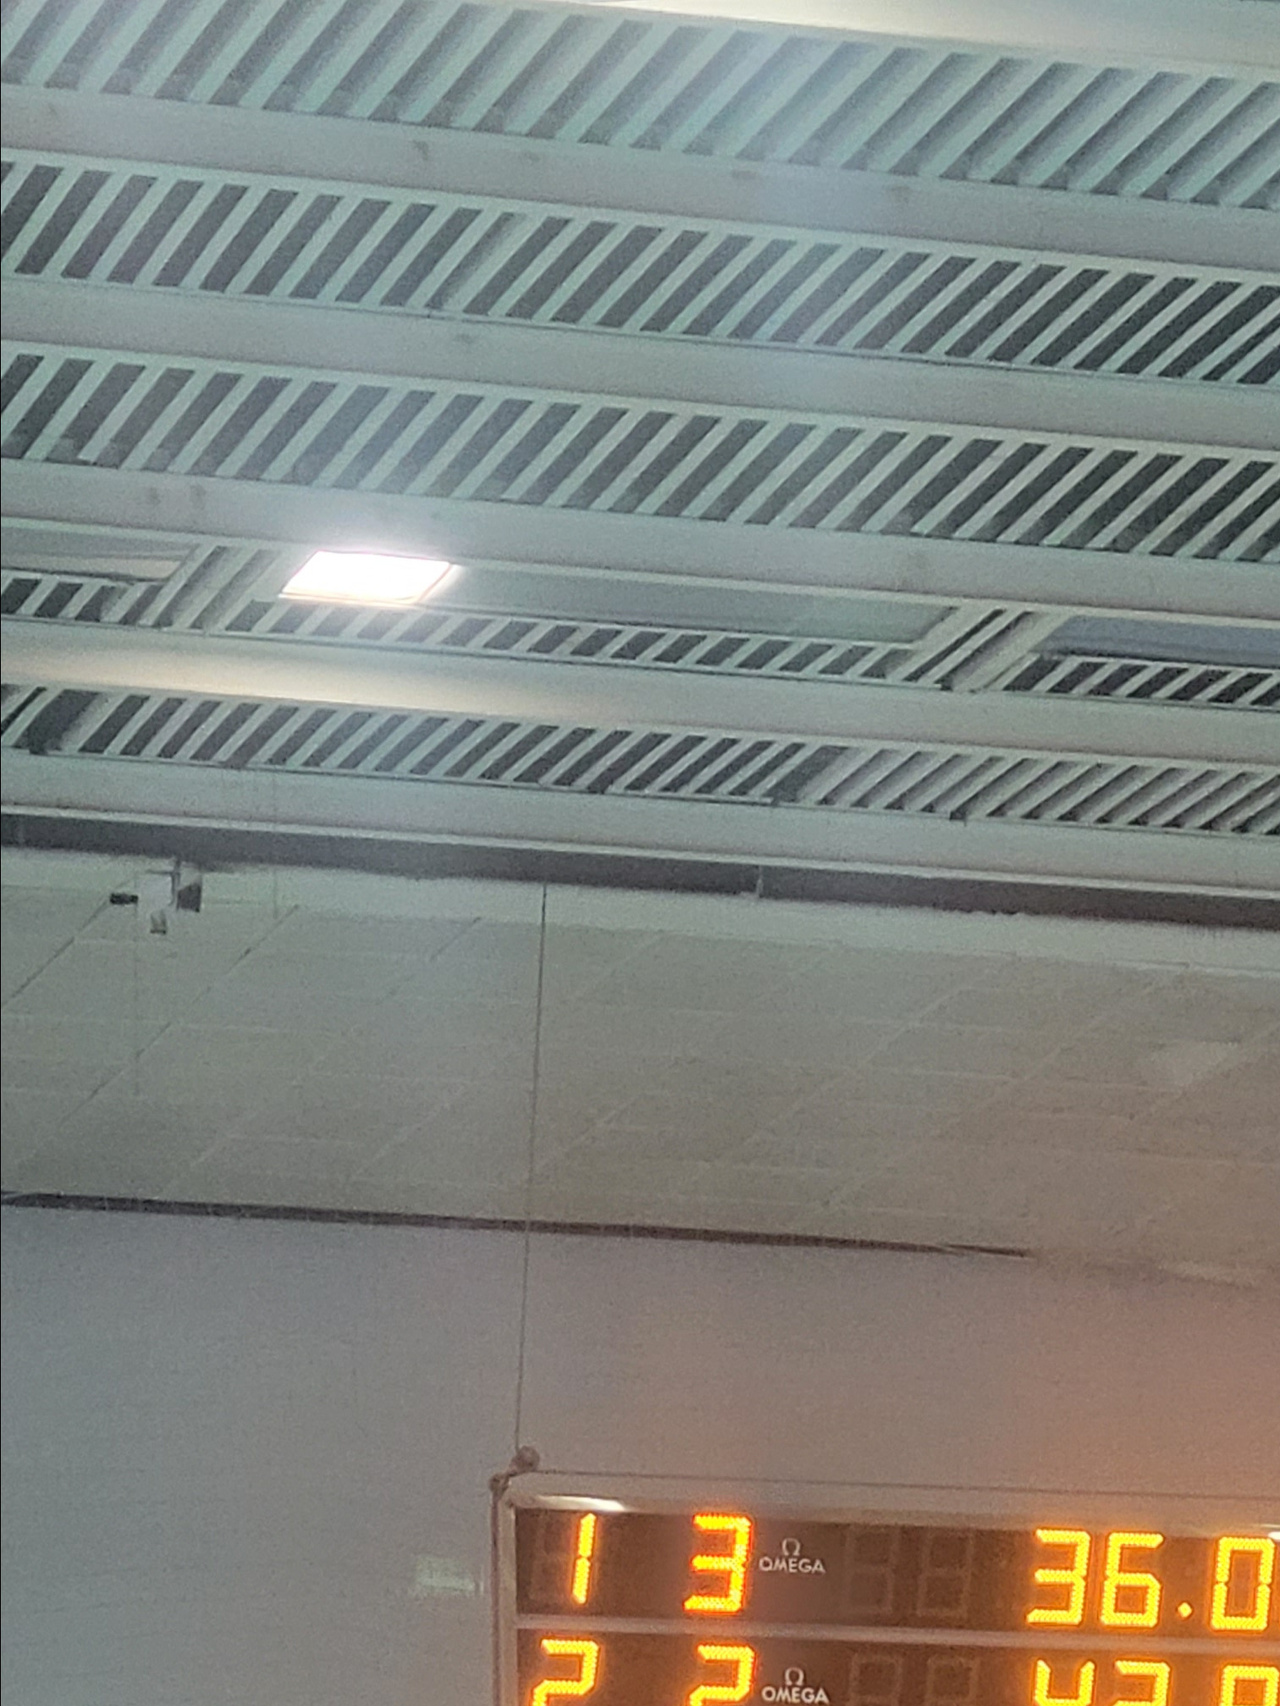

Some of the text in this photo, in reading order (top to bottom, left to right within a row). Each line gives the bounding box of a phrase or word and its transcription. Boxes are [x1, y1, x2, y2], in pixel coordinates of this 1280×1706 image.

[570, 1513, 598, 1604] 1
[683, 1511, 754, 1617] 3
[759, 1556, 826, 1575] OMEGA
[761, 1685, 829, 1704] OMEGA
